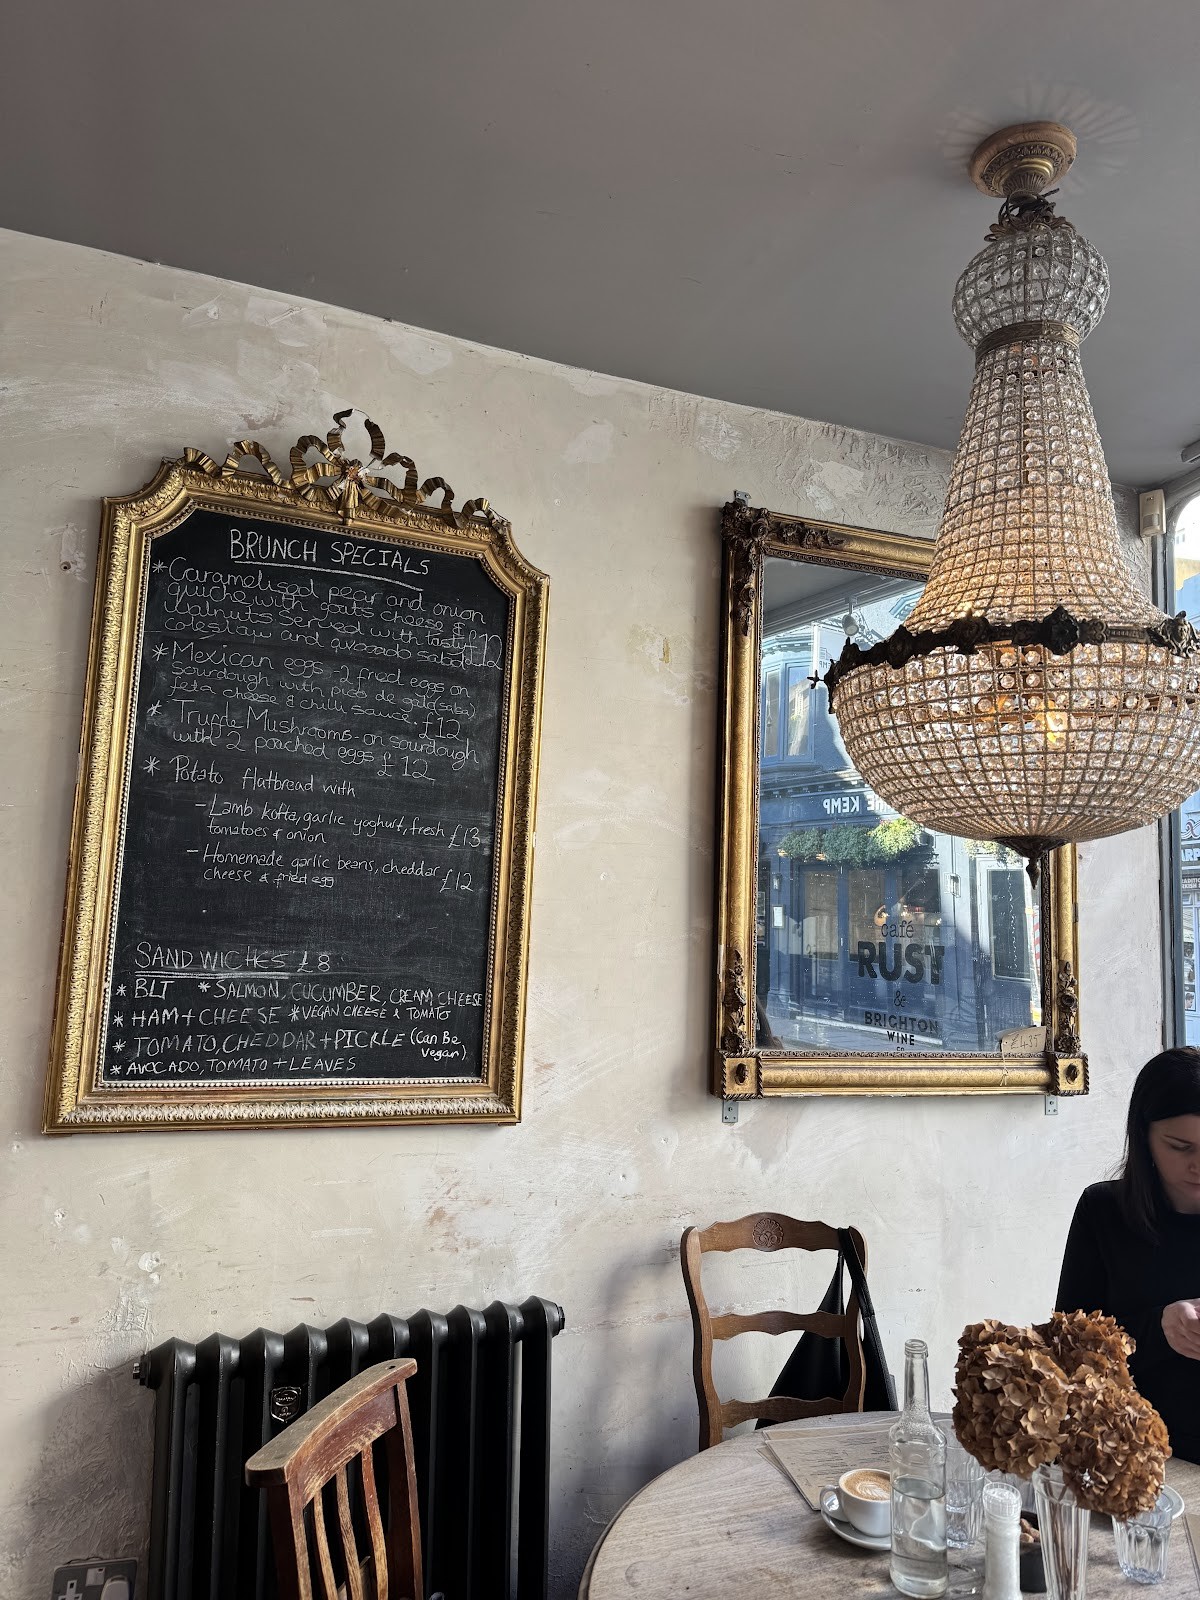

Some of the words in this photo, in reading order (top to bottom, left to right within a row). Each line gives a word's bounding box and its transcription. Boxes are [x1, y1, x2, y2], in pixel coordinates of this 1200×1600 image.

[230, 528, 317, 562] BRUNCH
[330, 541, 431, 575] SPECIALS
[168, 557, 319, 598] Caramelised
[328, 586, 383, 604] pear
[386, 592, 426, 612] and
[432, 602, 486, 624] onion
[167, 582, 251, 607] quiche
[251, 593, 309, 611] with
[380, 610, 444, 633] cheese
[280, 630, 325, 648] and
[370, 628, 424, 646] with
[172, 640, 274, 670] Mexican
[283, 657, 324, 679] eggs
[357, 667, 404, 690] fried
[409, 677, 445, 698] eggs
[449, 684, 471, 698] on
[279, 680, 325, 698] with
[375, 689, 397, 705] de
[168, 676, 217, 697] feta
[222, 687, 280, 705] cheese
[299, 698, 347, 714] chilli
[418, 712, 465, 742] £12
[172, 699, 244, 738] Truffle
[363, 733, 386, 747] on
[389, 735, 479, 771] sourdough
[173, 728, 217, 747] with
[225, 730, 246, 752] 2
[255, 736, 330, 760] poached
[337, 746, 375, 765] eggs
[169, 754, 224, 785] Potato
[242, 767, 314, 792] flatbread
[322, 780, 356, 798] with
[206, 816, 268, 837] tomatoes
[286, 829, 327, 844] onion
[208, 793, 253, 818] Lamb
[302, 810, 345, 831] garlic
[410, 816, 445, 837] fresh
[447, 824, 481, 849] £13
[203, 841, 284, 867] Homemade
[290, 854, 331, 875] garlic
[381, 859, 441, 877] cheddar
[439, 869, 474, 893] £12
[273, 870, 308, 888] fried
[311, 875, 335, 888] egg
[880, 920, 915, 939] café
[857, 940, 945, 985] RUST
[134, 978, 175, 1000] BLT
[389, 987, 433, 1005] CREAM
[437, 988, 483, 1007] CHEESE
[302, 1003, 340, 1021] VEGAN
[343, 1005, 387, 1019] CHEESE
[406, 1005, 452, 1020] TOMATO
[864, 1010, 938, 1035] BRIGHTON
[334, 1028, 406, 1050] PICKLE
[441, 1030, 462, 1046] Be
[886, 1030, 915, 1046] WINE
[1010, 1033, 1042, 1050] £435
[206, 1057, 269, 1073] TOMATO
[288, 1056, 357, 1072] LEAVES
